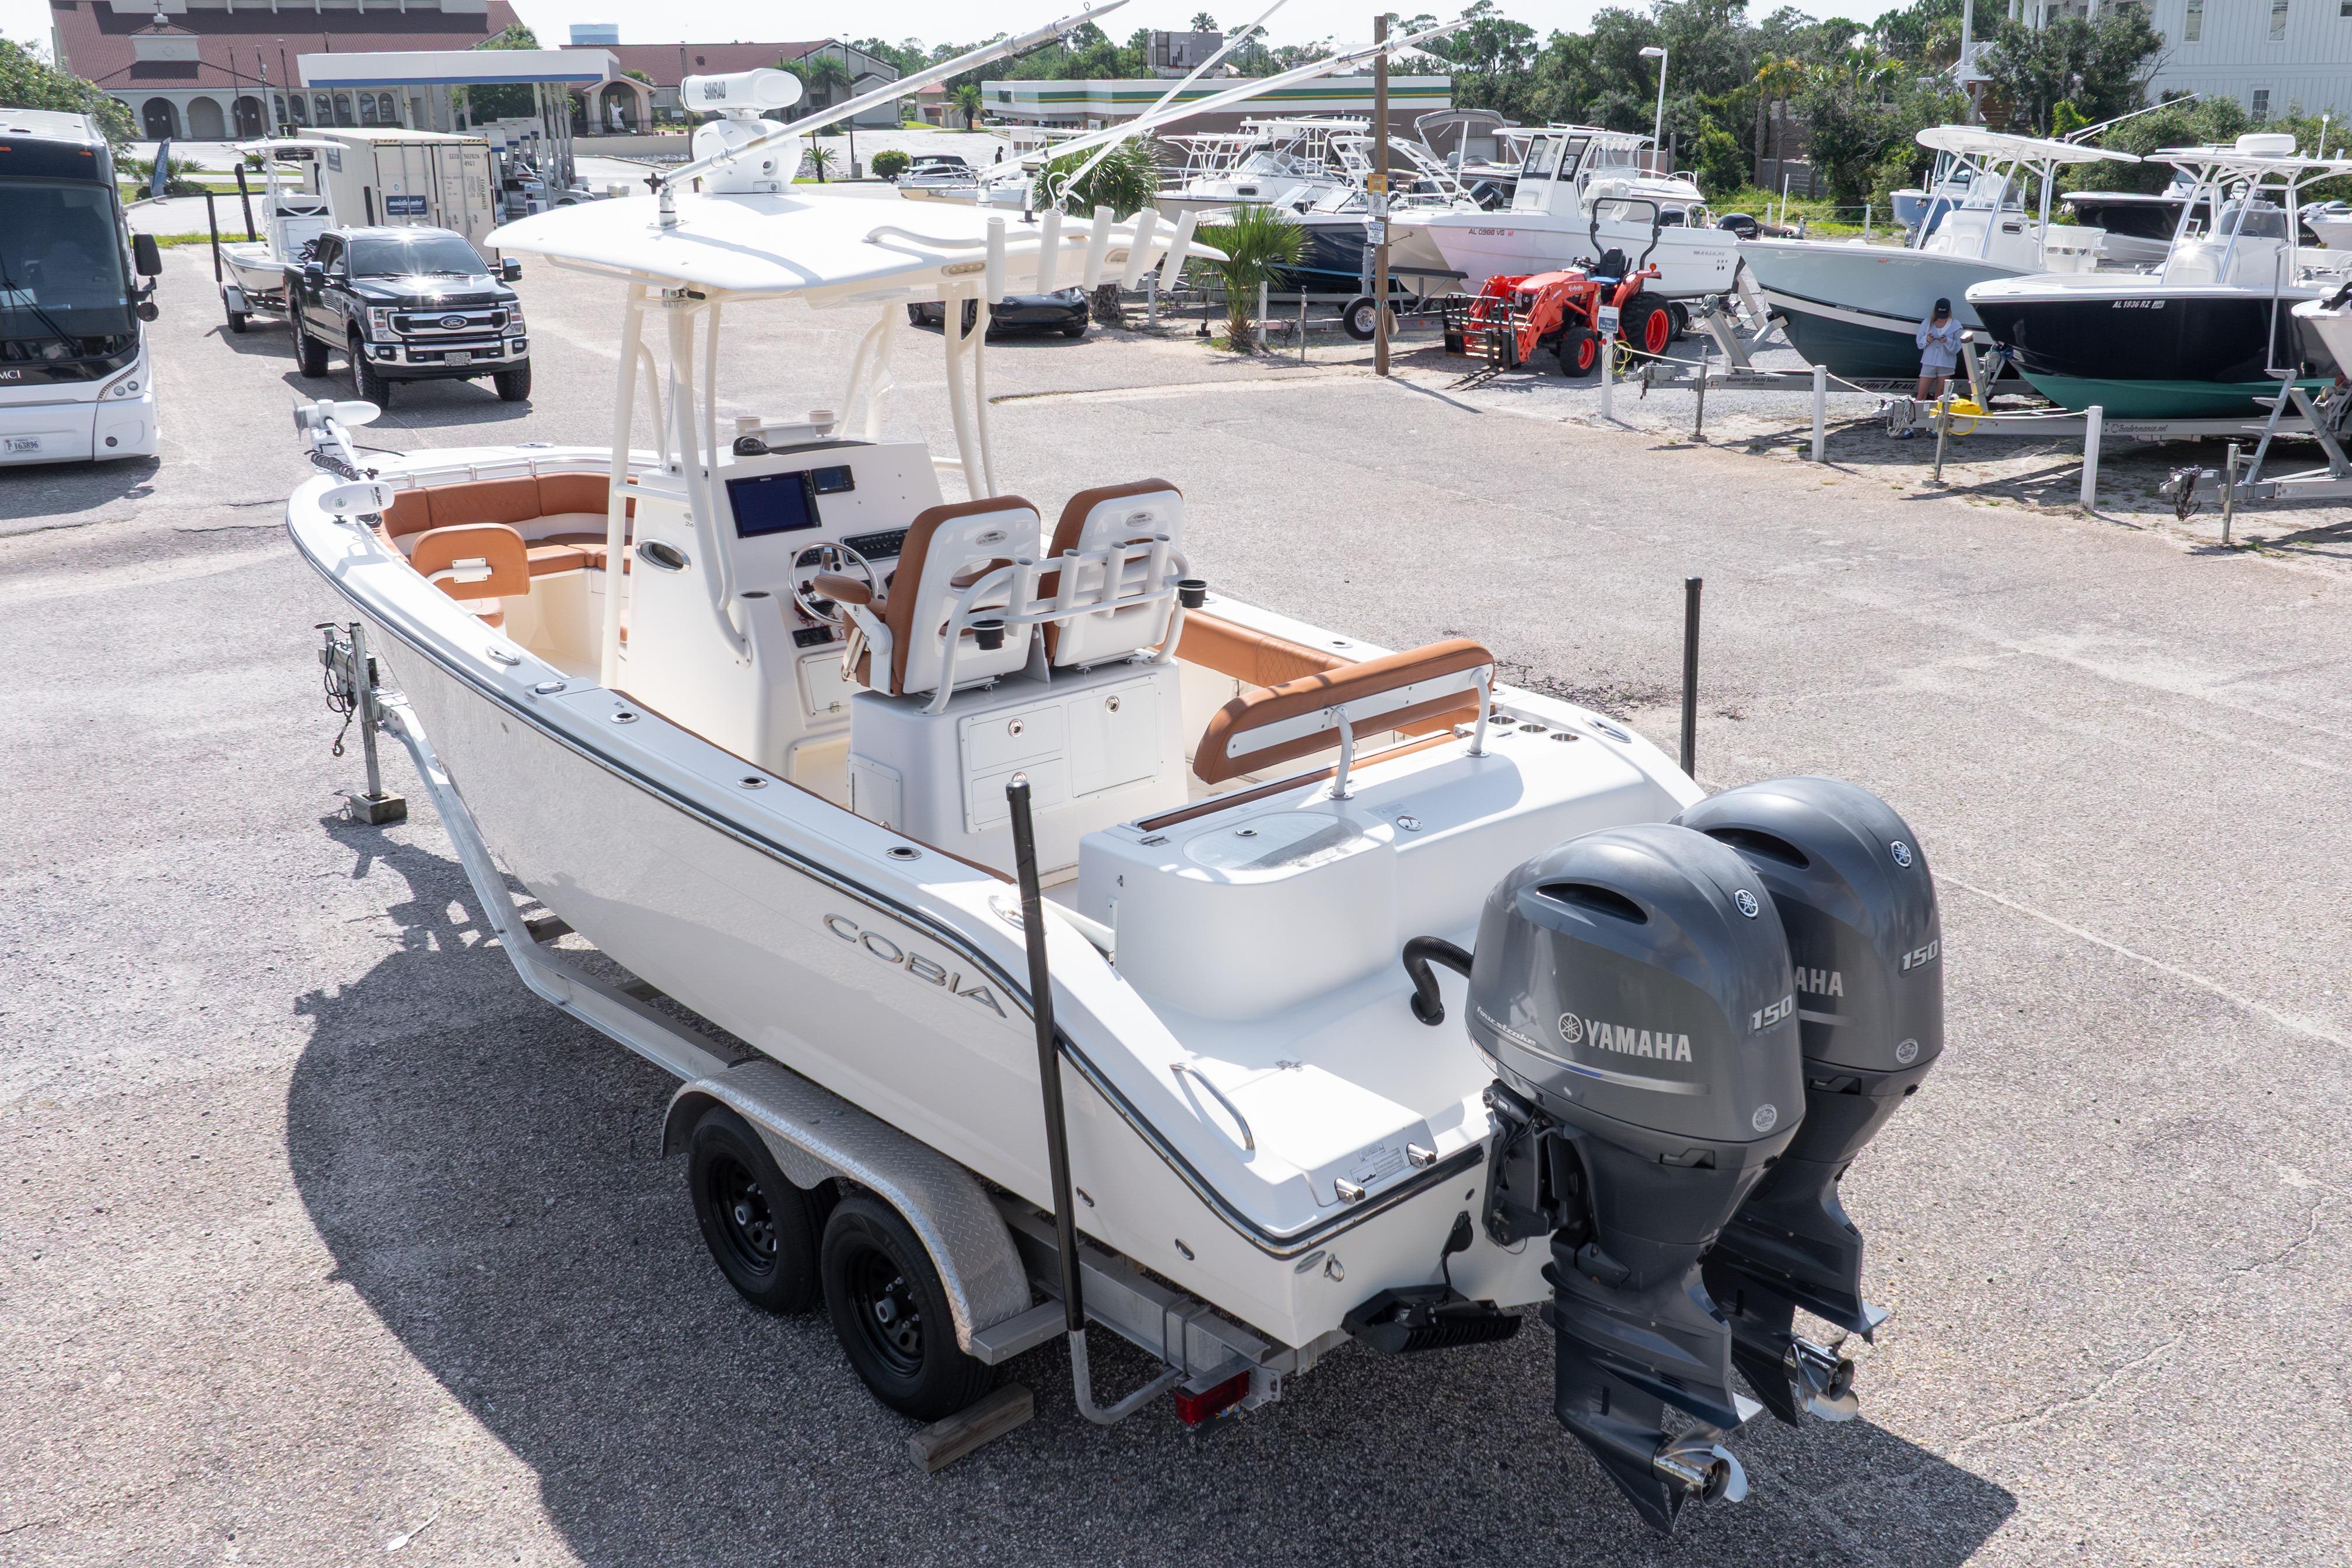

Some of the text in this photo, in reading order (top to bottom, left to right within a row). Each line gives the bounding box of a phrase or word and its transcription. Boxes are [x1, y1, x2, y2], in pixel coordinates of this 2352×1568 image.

[704, 81, 726, 100] SIMRAD
[823, 913, 1007, 1019] COBIA
[1903, 939, 1938, 971] 150
[1795, 965, 1844, 997] AHA
[1752, 994, 1793, 1030] 150
[1584, 1019, 1693, 1062] YAMAHA
